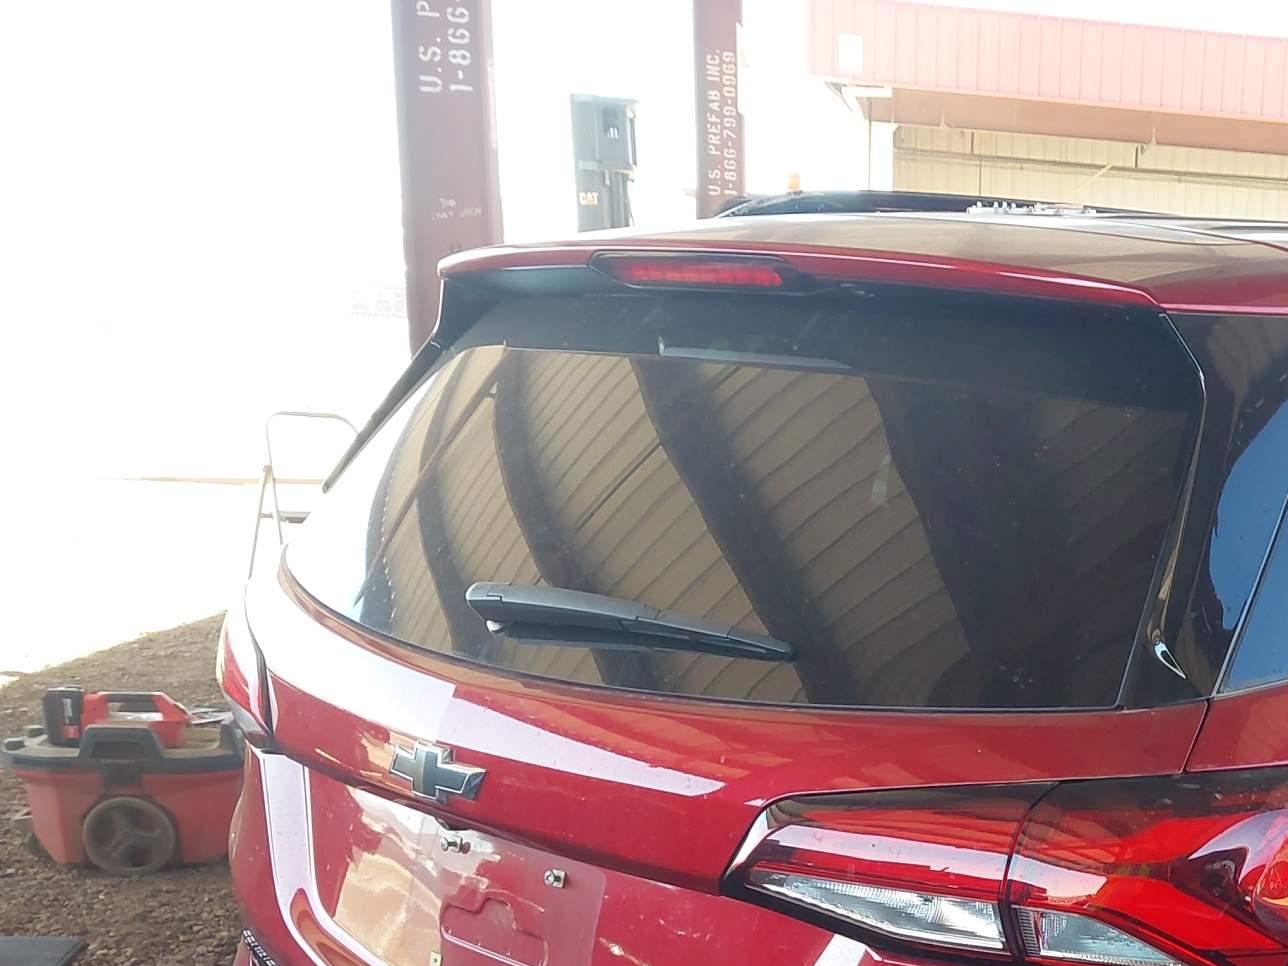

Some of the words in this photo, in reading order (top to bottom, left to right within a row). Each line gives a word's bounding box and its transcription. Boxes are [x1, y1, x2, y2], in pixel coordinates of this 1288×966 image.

[418, 37, 442, 92] U.S.
[447, 0, 473, 92] 1-866
[706, 49, 721, 81] INC.
[706, 89, 721, 155] PREFAB
[579, 191, 599, 206] CAT
[707, 165, 721, 196] U.S.
